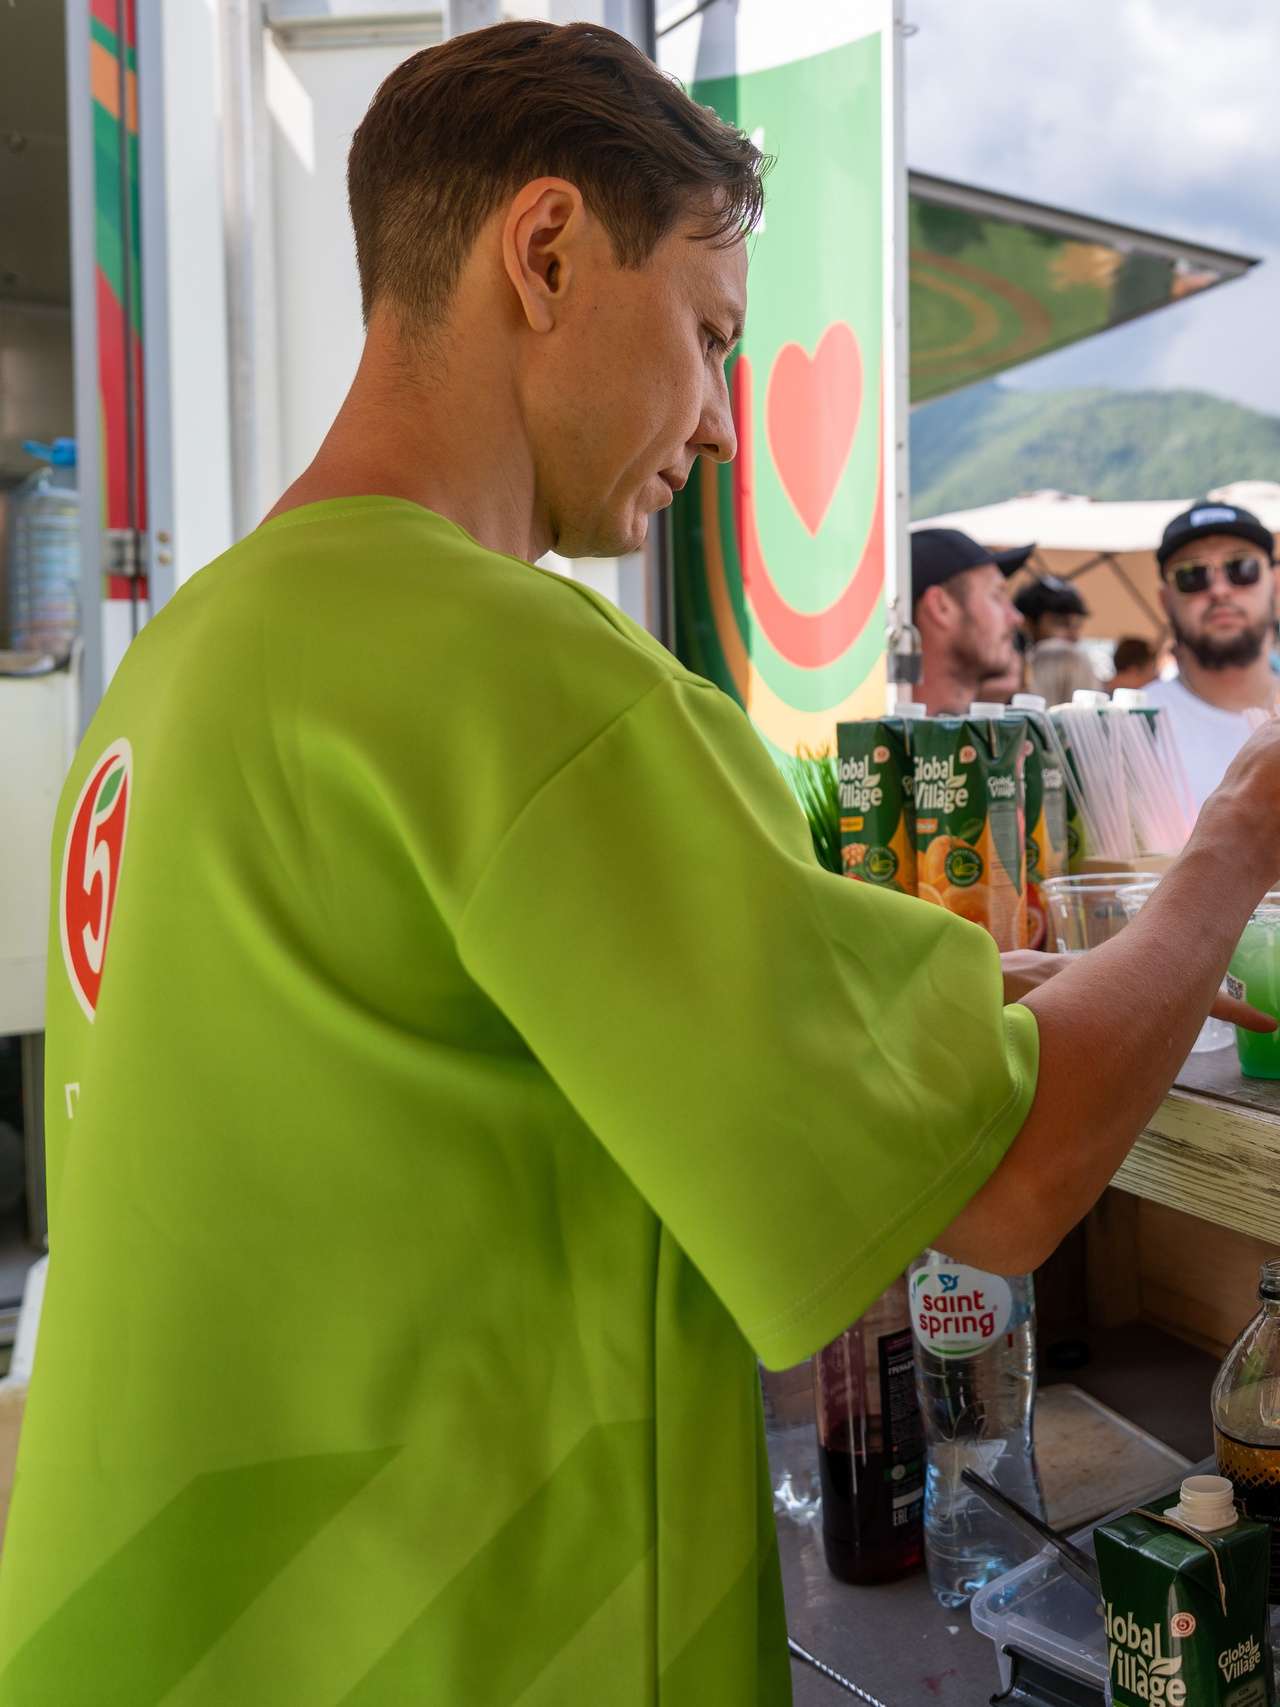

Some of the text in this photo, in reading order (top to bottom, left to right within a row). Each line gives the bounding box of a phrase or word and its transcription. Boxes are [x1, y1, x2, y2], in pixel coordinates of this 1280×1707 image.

[838, 754, 869, 780] lobal
[915, 782, 969, 814] Village
[922, 1290, 986, 1313] saint
[919, 1311, 995, 1339] spring
[1103, 1601, 1162, 1659] lobal
[1217, 1634, 1254, 1669] Global
[1222, 1651, 1261, 1684] Village
